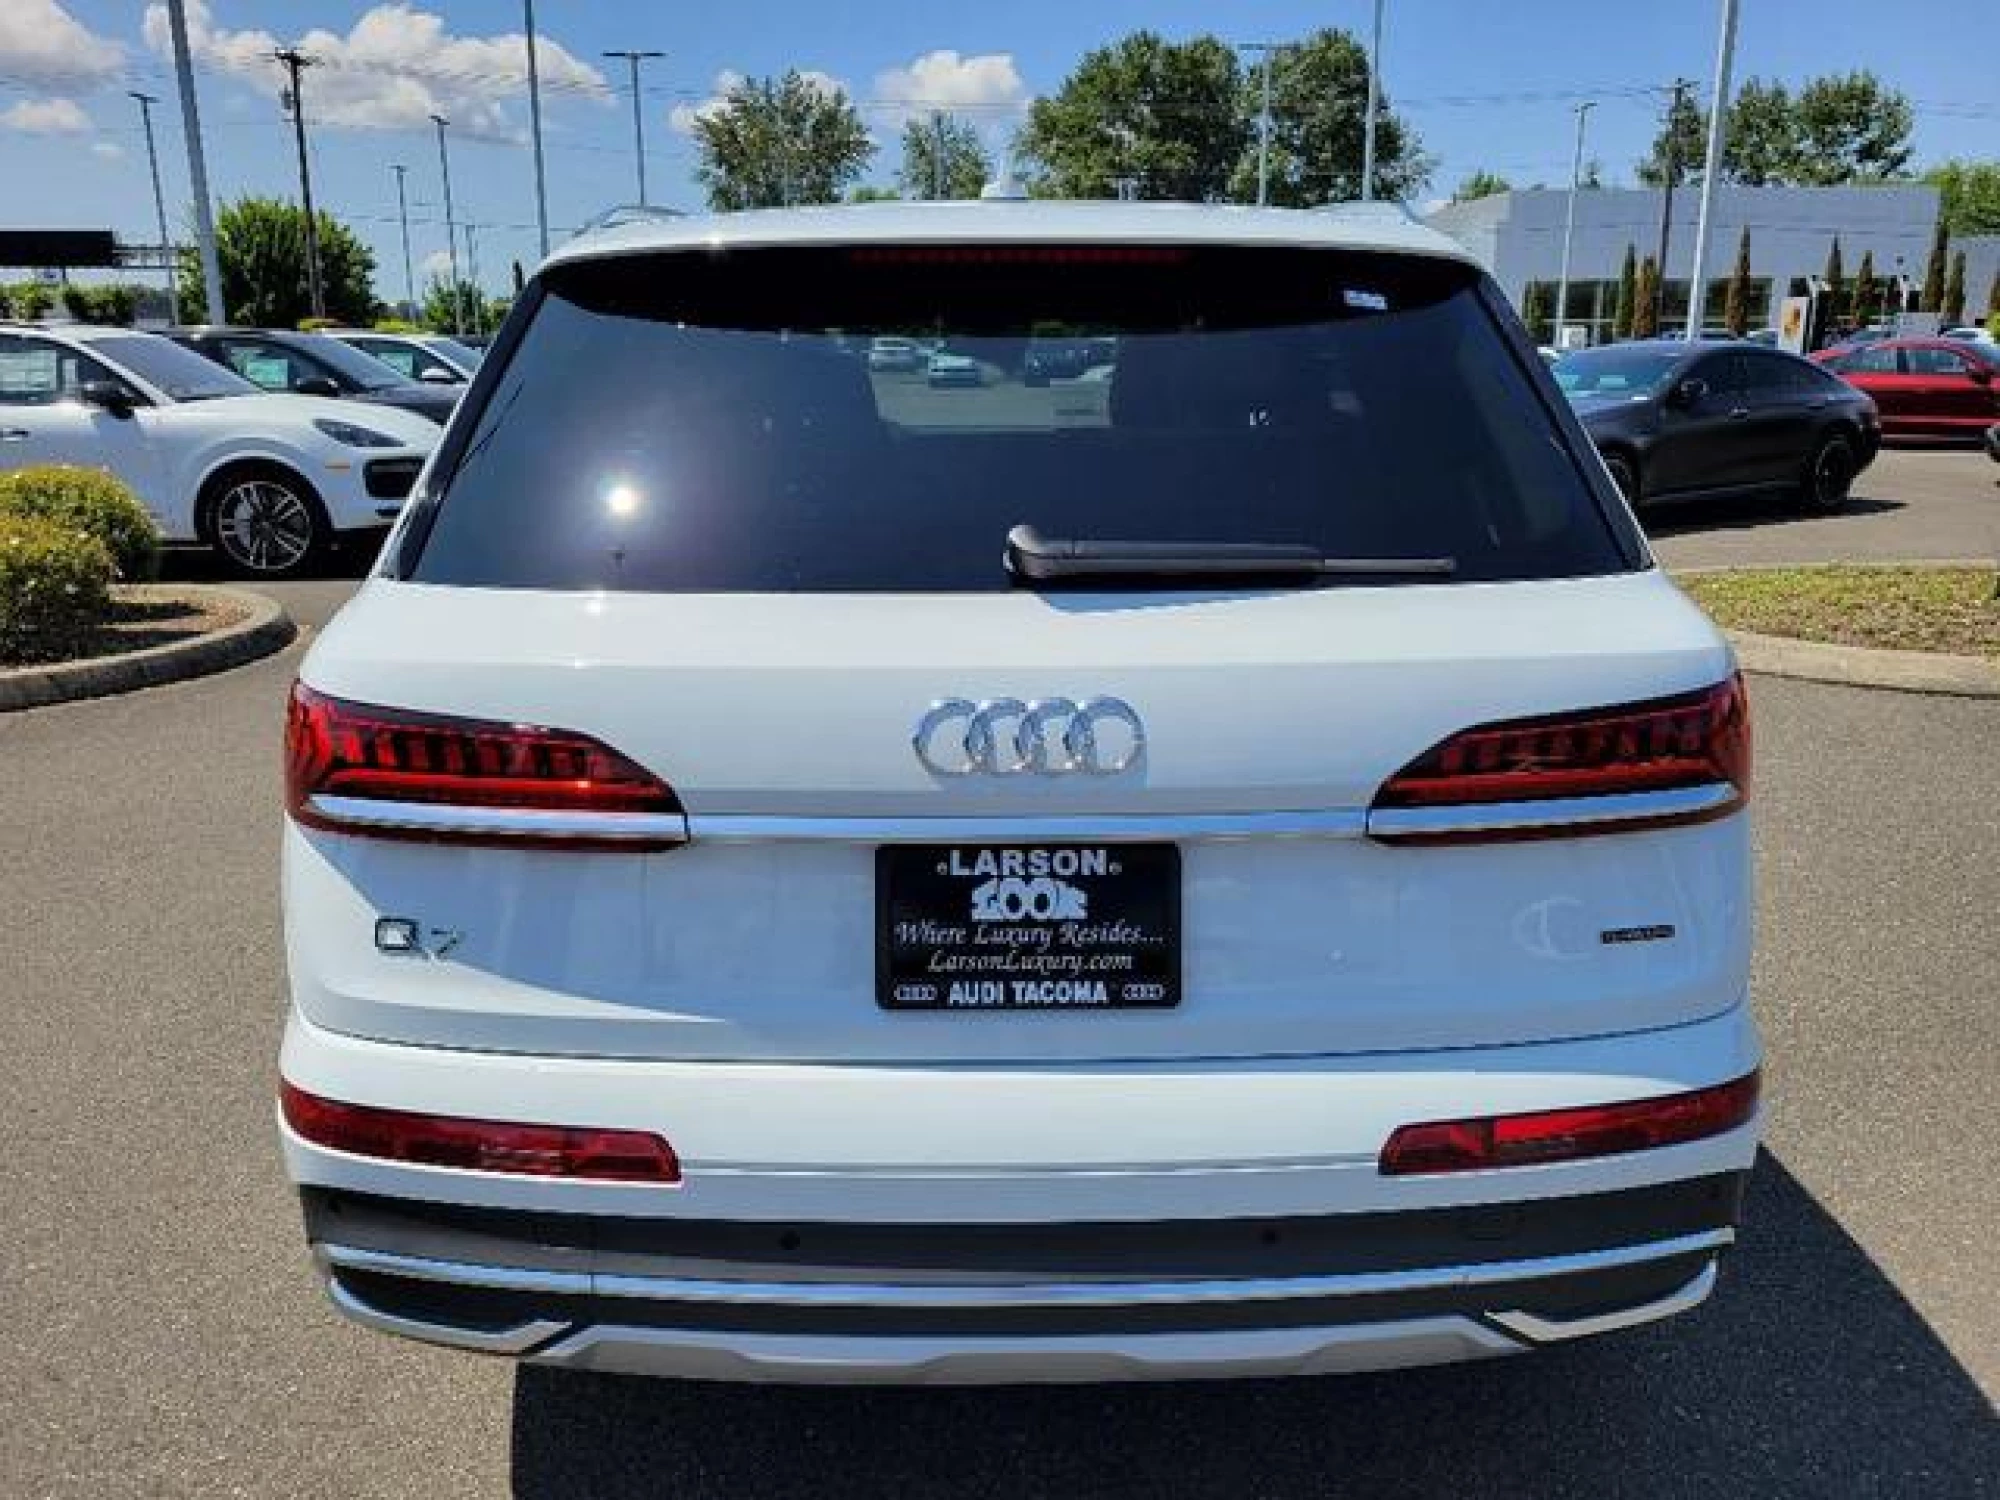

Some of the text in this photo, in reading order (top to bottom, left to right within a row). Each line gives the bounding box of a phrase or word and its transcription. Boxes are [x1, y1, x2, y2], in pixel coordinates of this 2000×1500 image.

[950, 849, 1107, 876] LARSON
[896, 920, 968, 945] Where
[975, 925, 1051, 950] Luxury
[949, 981, 1109, 1004] AUDI TACOMA
